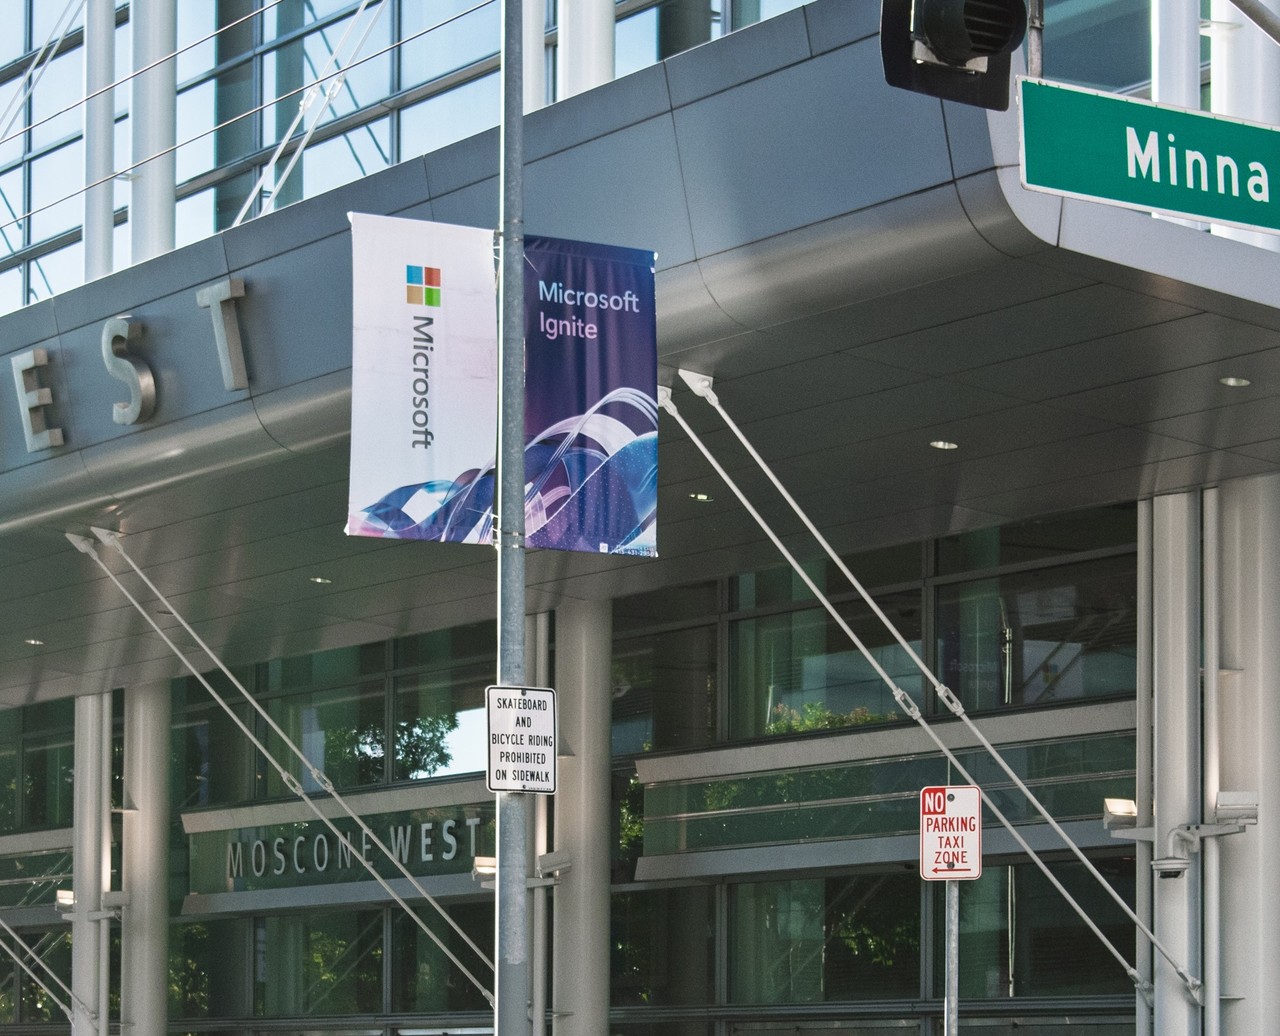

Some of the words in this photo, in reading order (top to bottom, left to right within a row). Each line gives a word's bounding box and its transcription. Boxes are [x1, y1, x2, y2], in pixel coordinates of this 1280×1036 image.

[1126, 126, 1270, 204] Minna
[538, 280, 641, 314] Microsoft
[539, 312, 599, 341] Ignite
[412, 315, 435, 450] Microsoft
[497, 698, 548, 711] SKATEBOARD
[515, 716, 532, 728] AND
[492, 734, 524, 746] BICYCLE
[529, 735, 553, 747] RIDING
[500, 752, 546, 764] PROHIBITED
[496, 769, 507, 781] ON
[512, 770, 550, 782] SIDEWALK
[925, 792, 945, 813] NO
[926, 816, 976, 833] PARKING
[227, 828, 373, 879] MOSCONE
[390, 817, 480, 865] WEST
[938, 836, 964, 849] TAXI
[934, 851, 968, 864] ZONE
